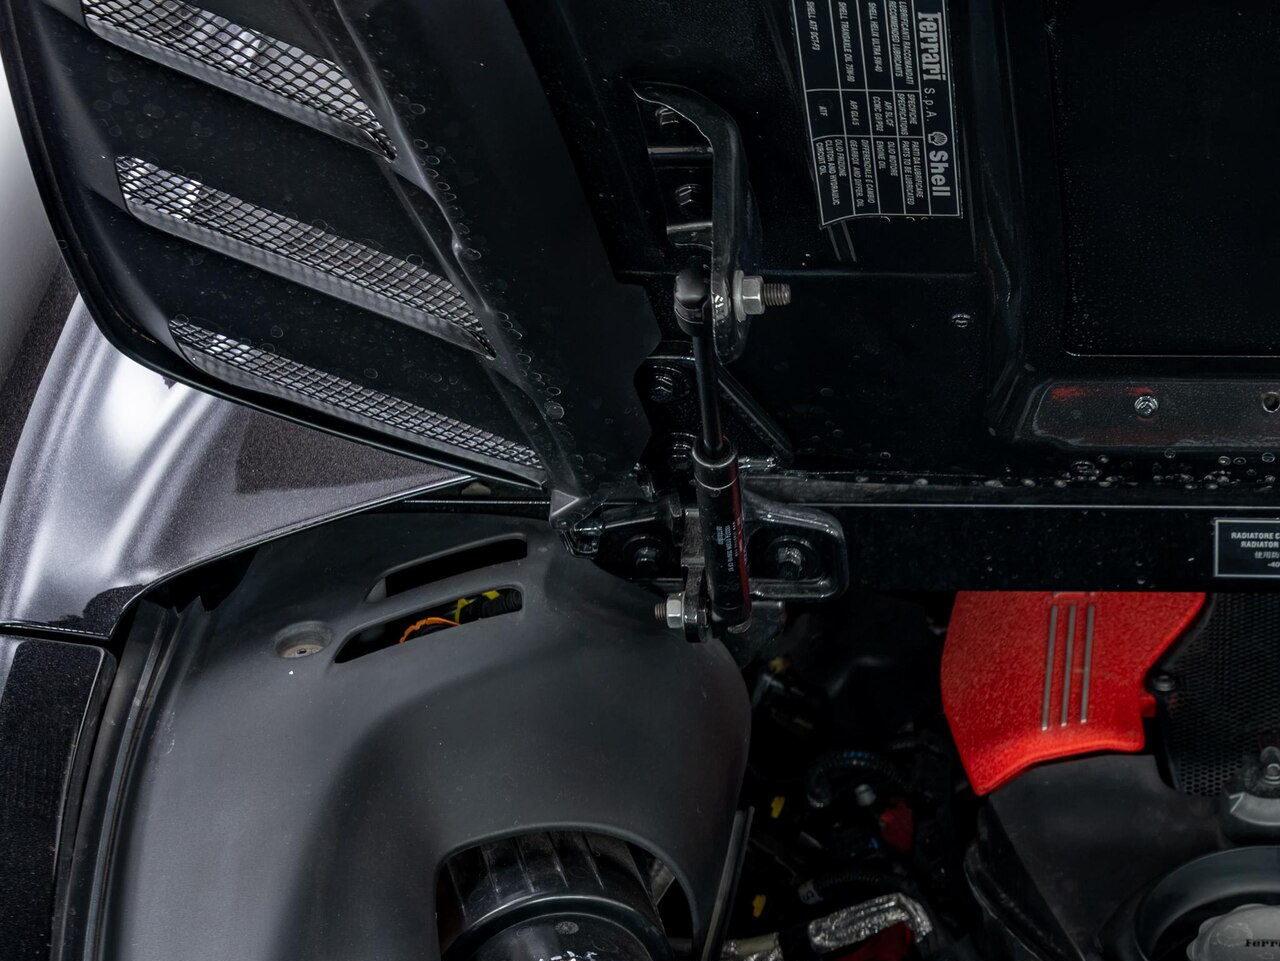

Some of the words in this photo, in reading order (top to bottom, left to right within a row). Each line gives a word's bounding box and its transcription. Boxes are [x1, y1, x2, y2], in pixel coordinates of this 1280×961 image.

[806, 1, 816, 18] SHELL
[868, 2, 877, 19] SHELL
[898, 1, 910, 40] LUBRIFICANTI
[808, 19, 817, 30] ATF
[838, 1, 848, 19] SHELL
[844, 53, 852, 62] OIL
[869, 20, 879, 37] HELIX
[888, 0, 899, 42] RECOMMENDED
[871, 38, 880, 55] ULTRA
[917, 12, 945, 80] Ferrari
[892, 43, 902, 77] LUBRICANTS
[902, 41, 913, 84] RACCOMANDATI
[818, 105, 827, 116] ATF
[897, 93, 908, 135] SPECIFICATIONS
[907, 94, 917, 124] SPECIFICHE
[921, 87, 937, 121] S.p.A.
[815, 142, 825, 163] CIRCUIT
[824, 139, 834, 161] CLUTCH
[834, 139, 843, 151] OLIO
[849, 139, 859, 164] GEARBOX
[876, 140, 885, 160] ENGINE
[887, 141, 895, 154] OLIO
[901, 140, 910, 157] PARTS
[911, 141, 919, 156] PARTI
[827, 162, 836, 173] AND
[836, 152, 846, 176] FRIZIONE
[860, 139, 872, 178] DIFFERENZIALE
[888, 154, 897, 176] MOTORE
[818, 165, 826, 175] OIL
[852, 166, 861, 177] AND
[913, 165, 923, 197] LUBRIFICARE
[928, 150, 950, 195] Shell
[829, 175, 840, 205] HYDRAULIC
[865, 183, 875, 203] CAMBIO
[904, 174, 914, 205] LUBRICATED
[856, 198, 864, 207] OIL
